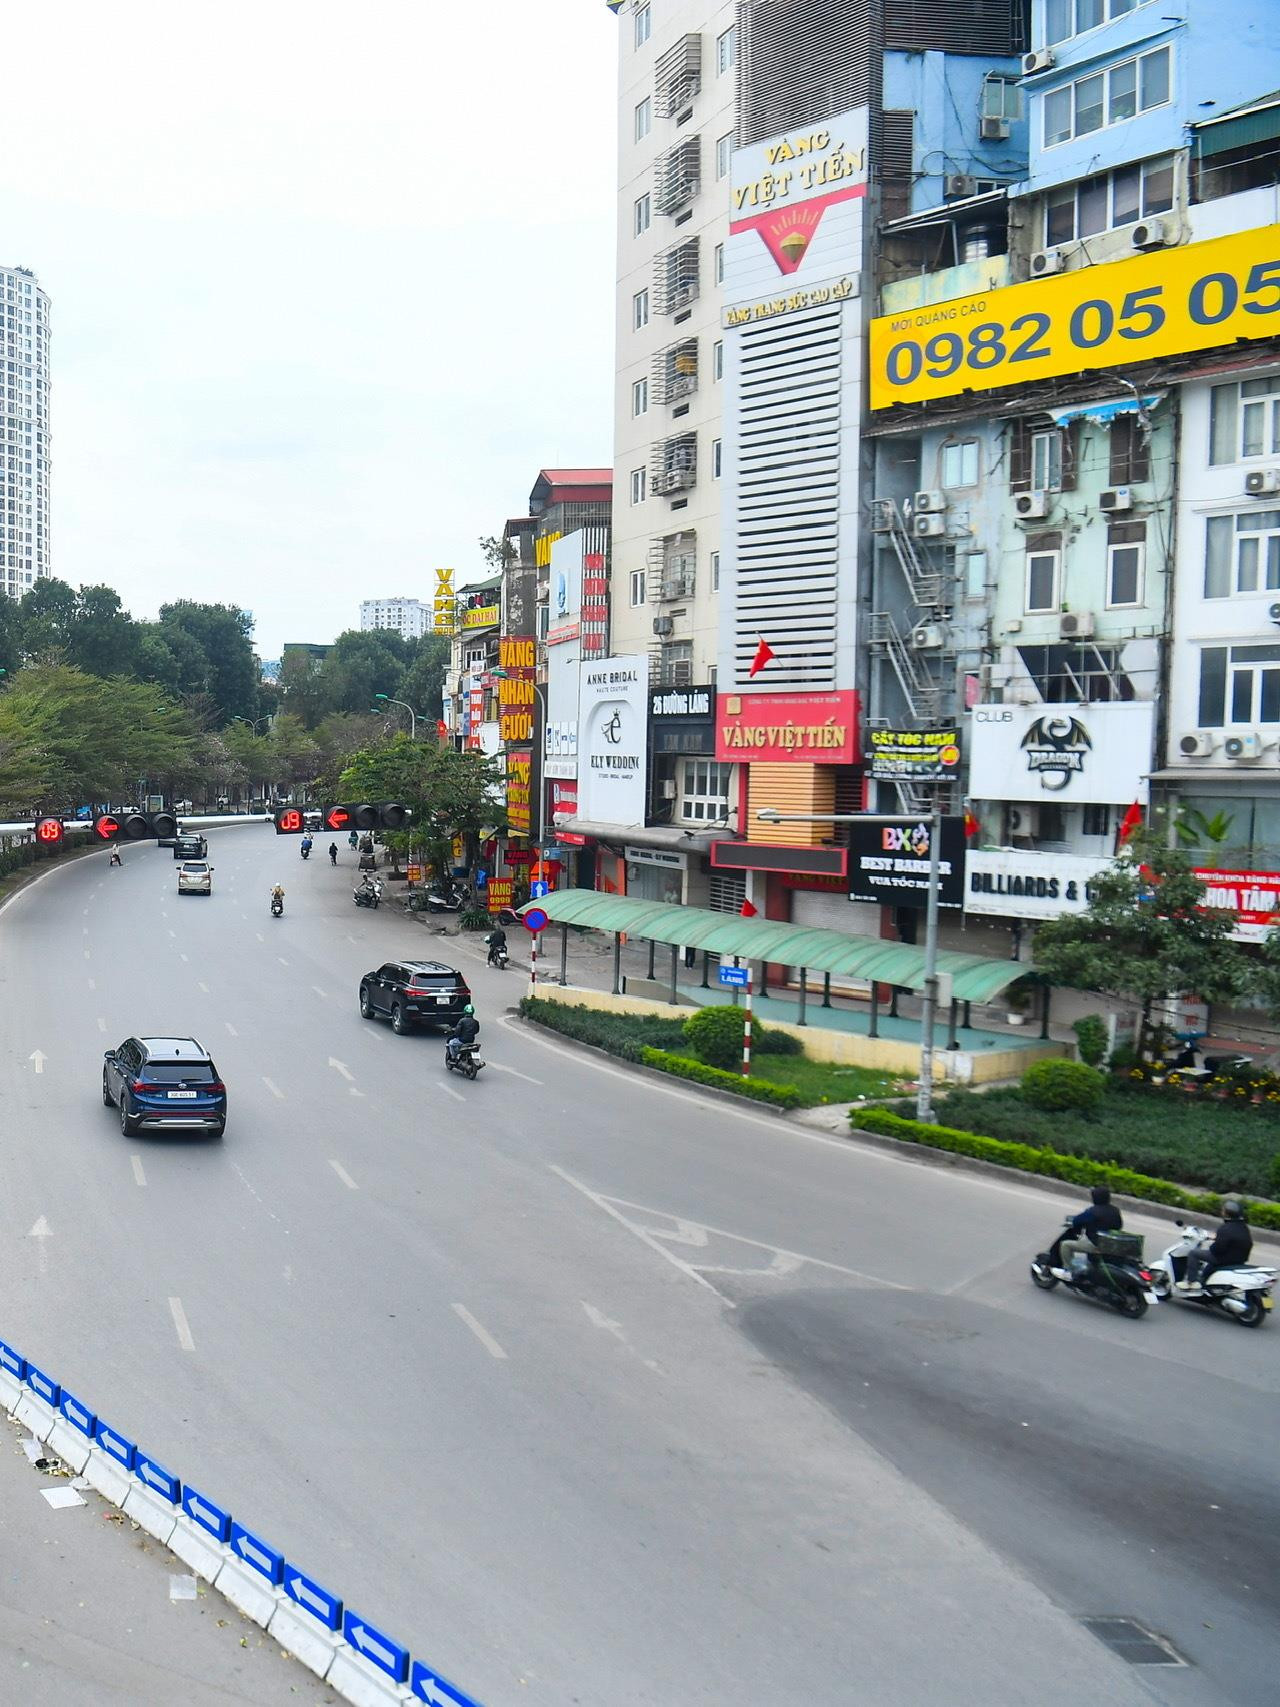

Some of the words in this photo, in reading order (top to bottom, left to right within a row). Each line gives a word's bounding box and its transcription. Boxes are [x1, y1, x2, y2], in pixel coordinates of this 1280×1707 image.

[763, 128, 831, 165] VÀNG
[732, 169, 793, 210] VIỆT
[799, 142, 866, 190] TIẾN
[727, 304, 752, 325] VÀNG
[754, 299, 787, 320] TRANG
[788, 290, 809, 310] SỨC
[810, 287, 831, 305] CAO
[832, 277, 853, 300] CẤP
[885, 312, 1052, 387] 0982
[1070, 285, 1166, 349] 05
[1187, 260, 1280, 326] 05
[500, 635, 534, 667] VÀNG
[499, 669, 534, 705] NHẪN
[587, 673, 607, 685] ANNE
[609, 670, 638, 684] BRIDAL
[688, 688, 709, 714] LÁNG
[502, 706, 534, 741] CƯỚI
[976, 711, 1014, 723] CLUB
[723, 720, 766, 748] VÀNG
[767, 720, 806, 753] VIỆT
[806, 716, 847, 748] TIẾN
[591, 755, 604, 769] ELY
[1030, 751, 1081, 769] DRAGON
[41, 822, 59, 839] 09
[281, 812, 300, 830] 09
[860, 856, 894, 871] BEST
[489, 880, 511, 896] VÀNG
[971, 872, 1060, 899] BILLIARDS
[1066, 880, 1078, 901] &
